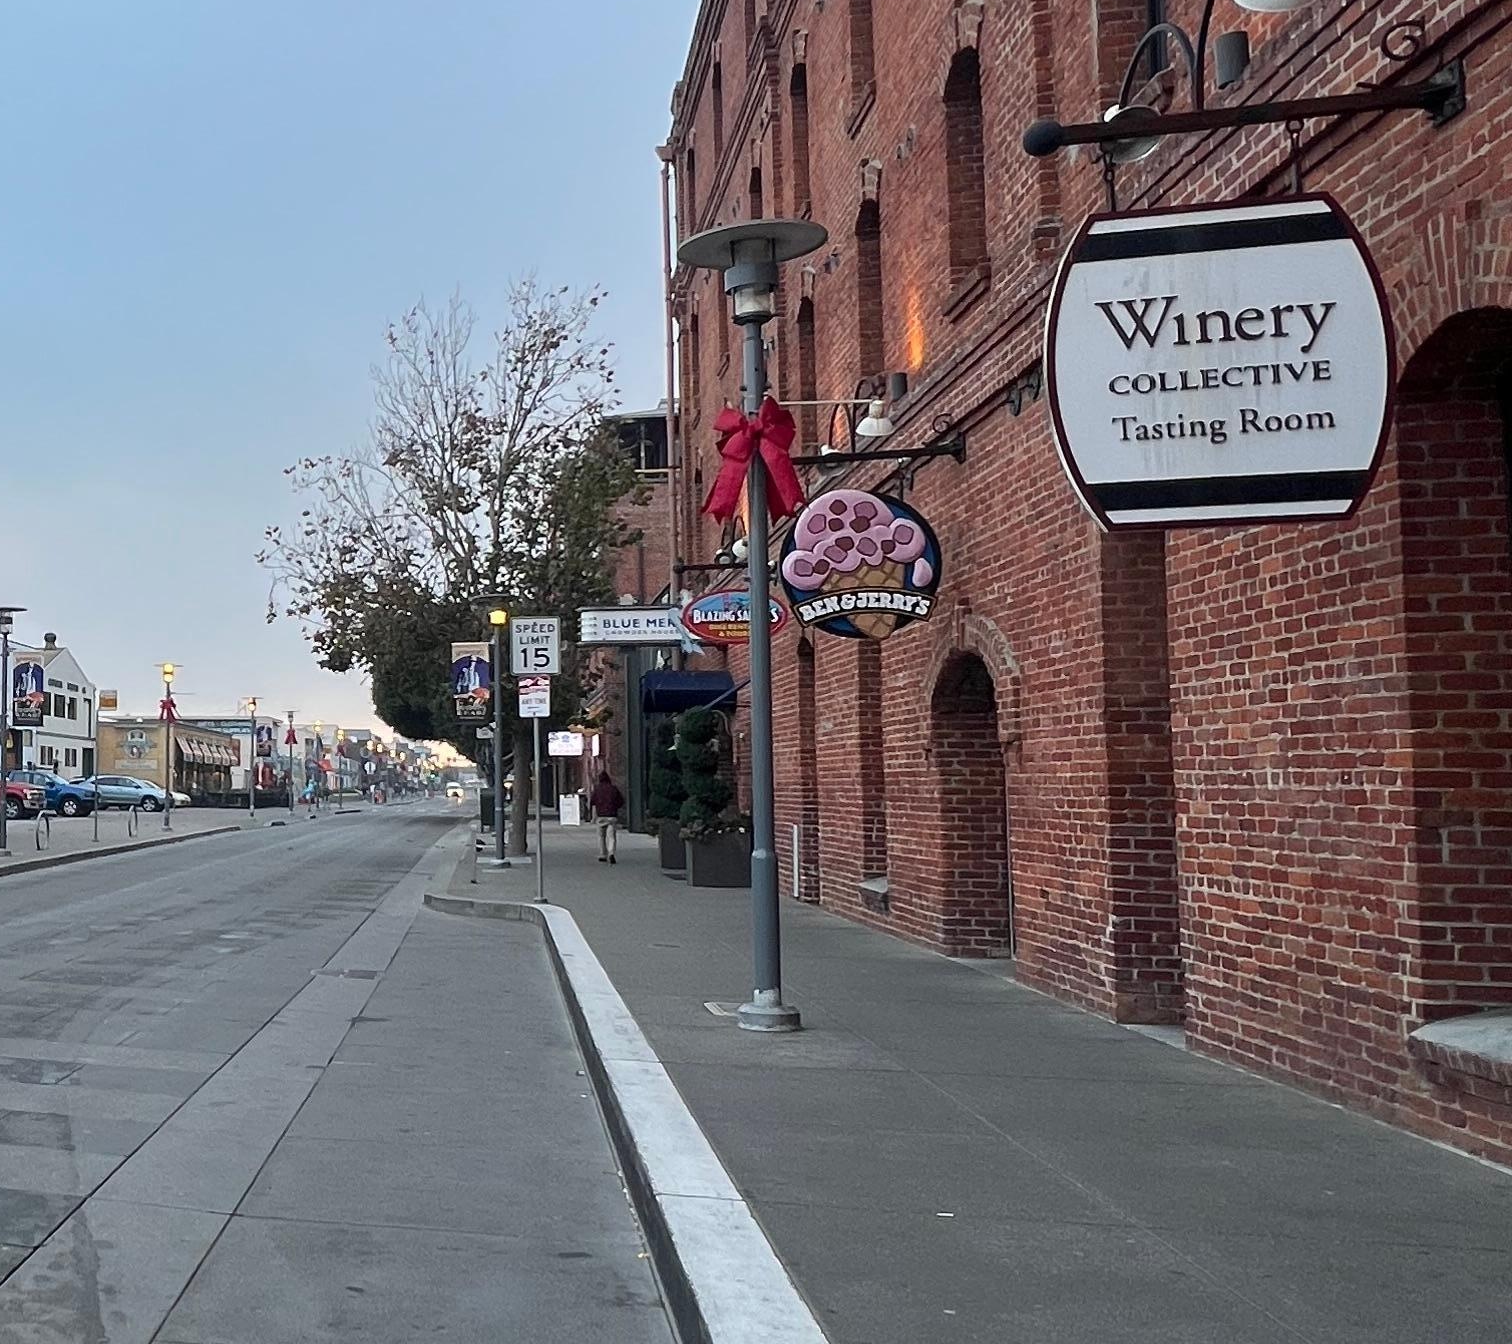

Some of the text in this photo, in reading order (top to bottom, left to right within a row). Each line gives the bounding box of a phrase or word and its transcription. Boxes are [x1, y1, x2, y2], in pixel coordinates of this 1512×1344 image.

[1094, 295, 1337, 353] Winery
[1108, 360, 1331, 394] COLLECTIVE
[1111, 408, 1336, 444] Tasting Room
[603, 619, 640, 629] BLUE
[693, 609, 735, 624] BLAZING
[515, 624, 555, 634] SPEED
[519, 636, 550, 645] LIMIT
[521, 648, 550, 668] 15
